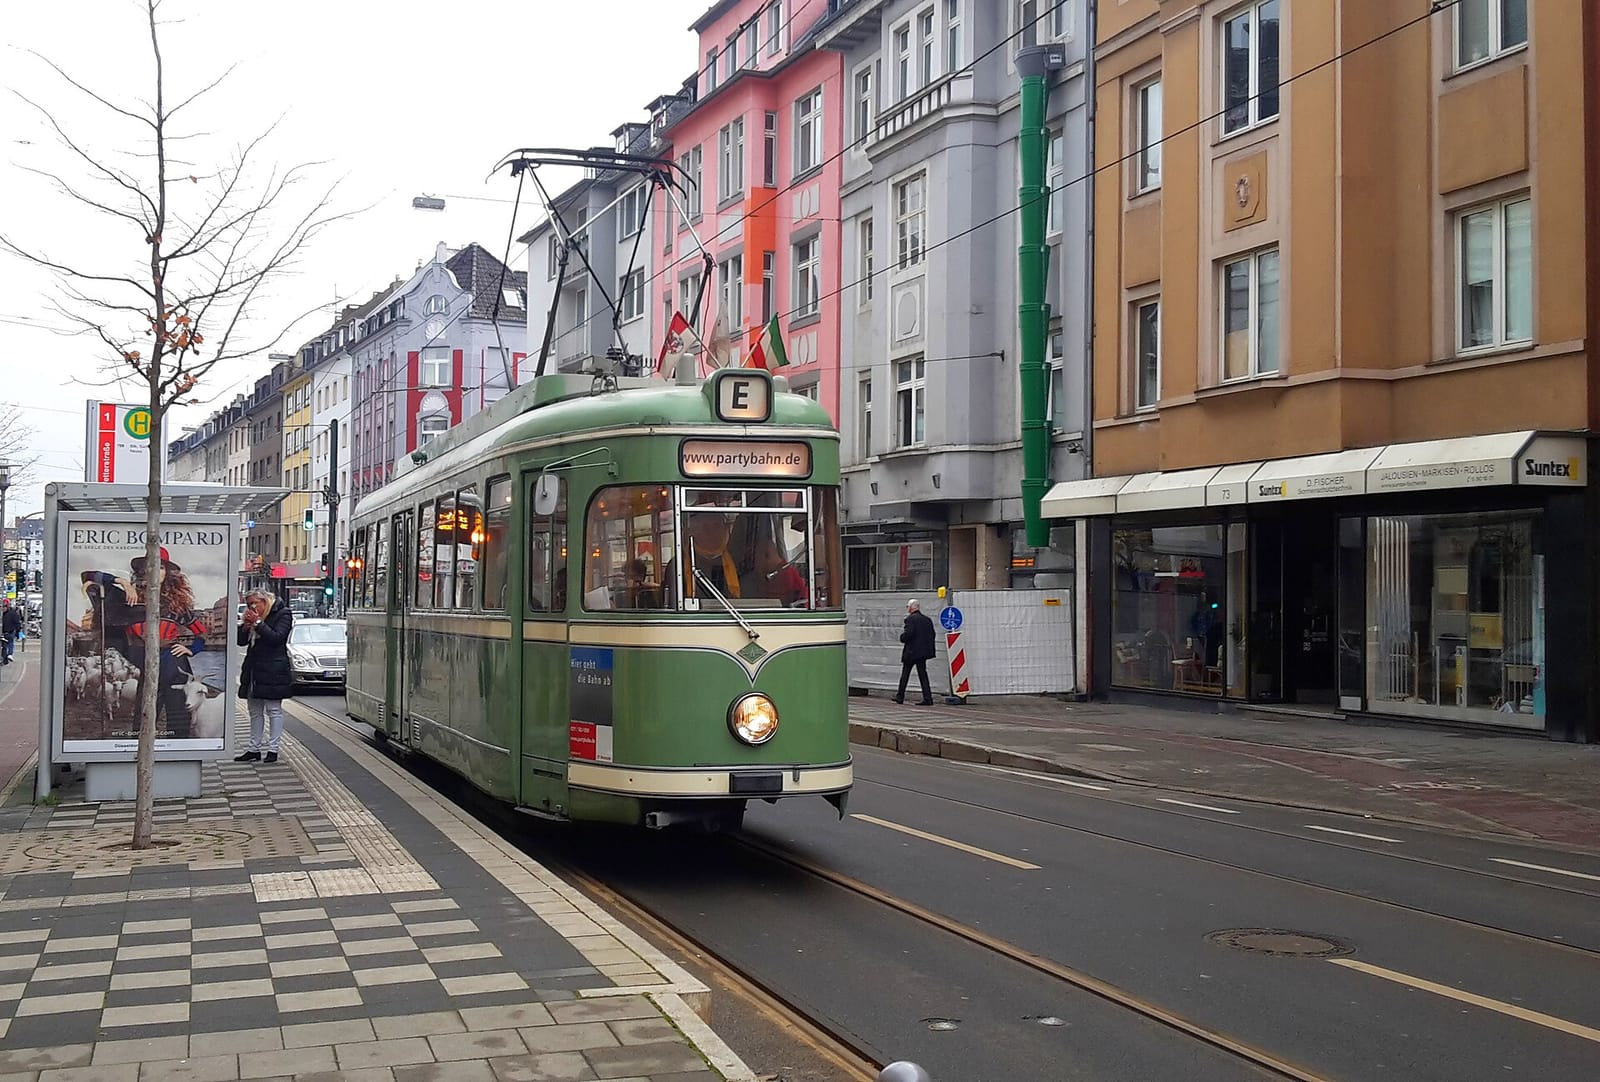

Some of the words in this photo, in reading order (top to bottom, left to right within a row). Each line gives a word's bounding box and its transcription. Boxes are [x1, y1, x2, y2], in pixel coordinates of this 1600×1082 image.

[732, 382, 749, 409] E
[104, 412, 110, 422] 1
[134, 414, 148, 433] H
[103, 442, 111, 482] etterstraße
[1525, 459, 1570, 477] Suntex
[1314, 476, 1345, 486] FISCHER
[1222, 490, 1231, 500] 73
[1259, 485, 1283, 497] Suntex
[73, 529, 120, 544] ERIC
